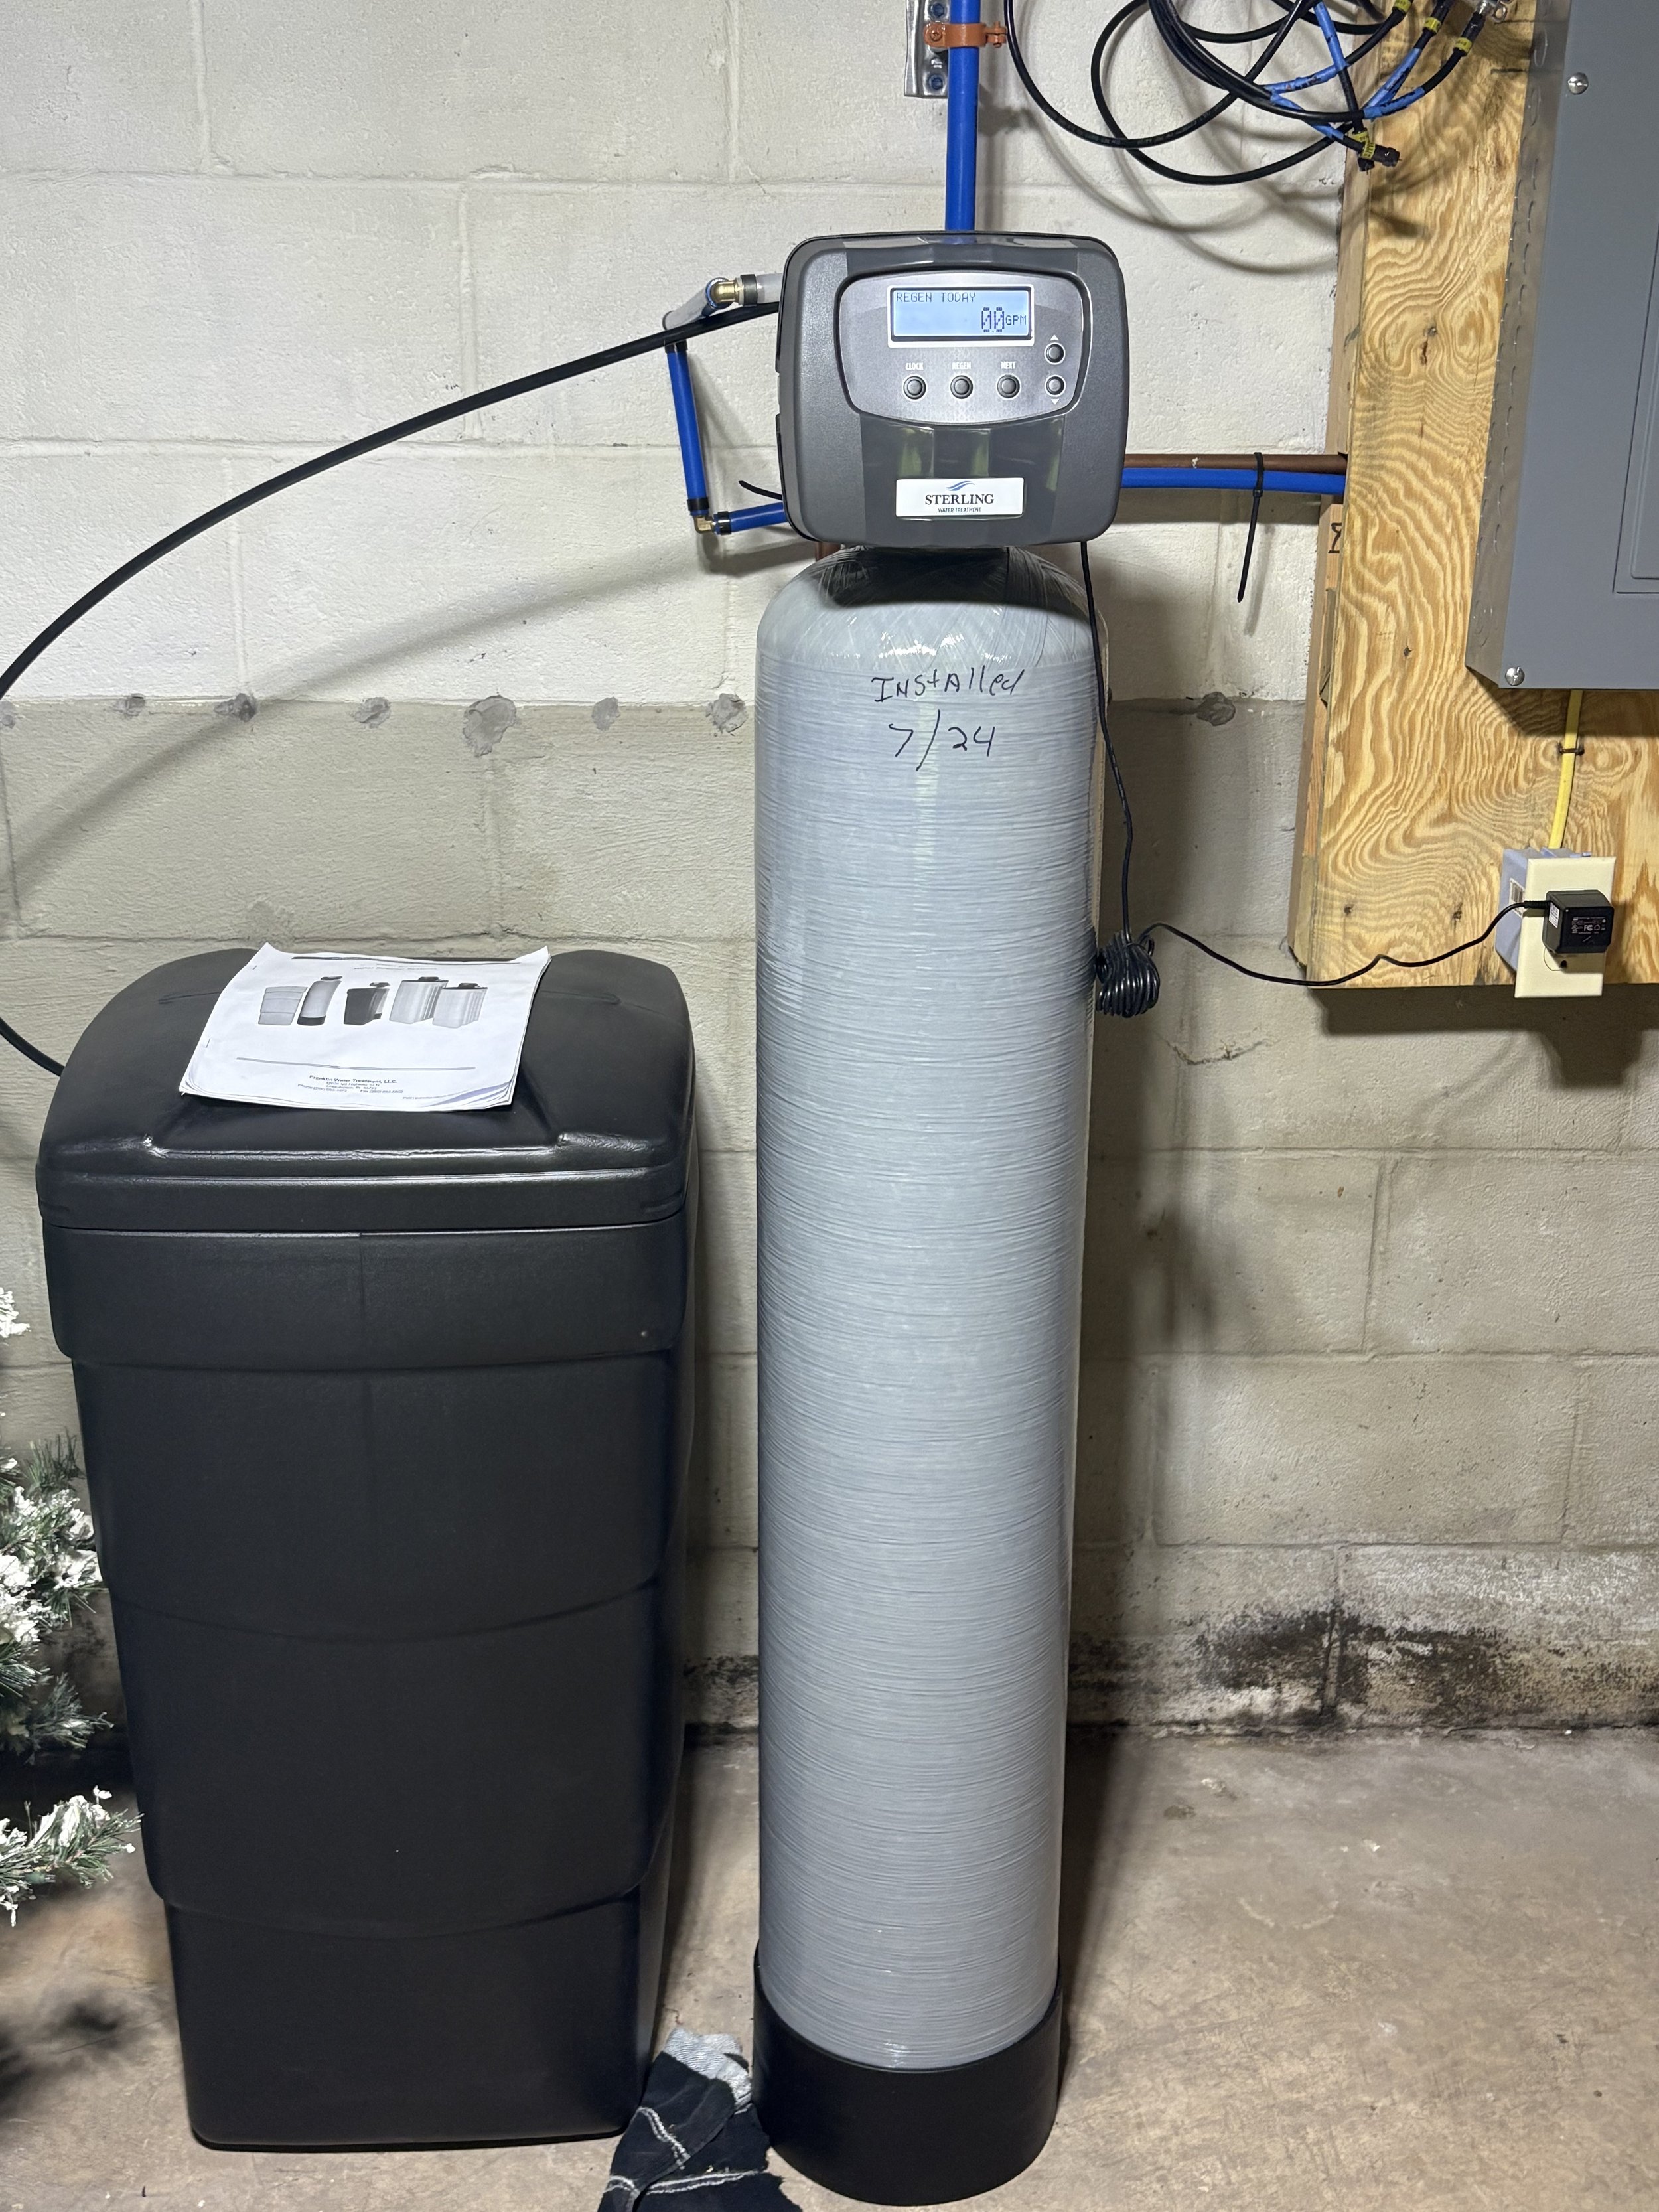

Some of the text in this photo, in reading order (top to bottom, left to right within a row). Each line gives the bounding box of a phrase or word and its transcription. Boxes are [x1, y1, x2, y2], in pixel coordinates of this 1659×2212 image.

[896, 291, 975, 303] REGEN TODAY
[1005, 315, 1027, 325] GPM
[925, 494, 994, 505] STERLING
[888, 709, 996, 771] 7/24
